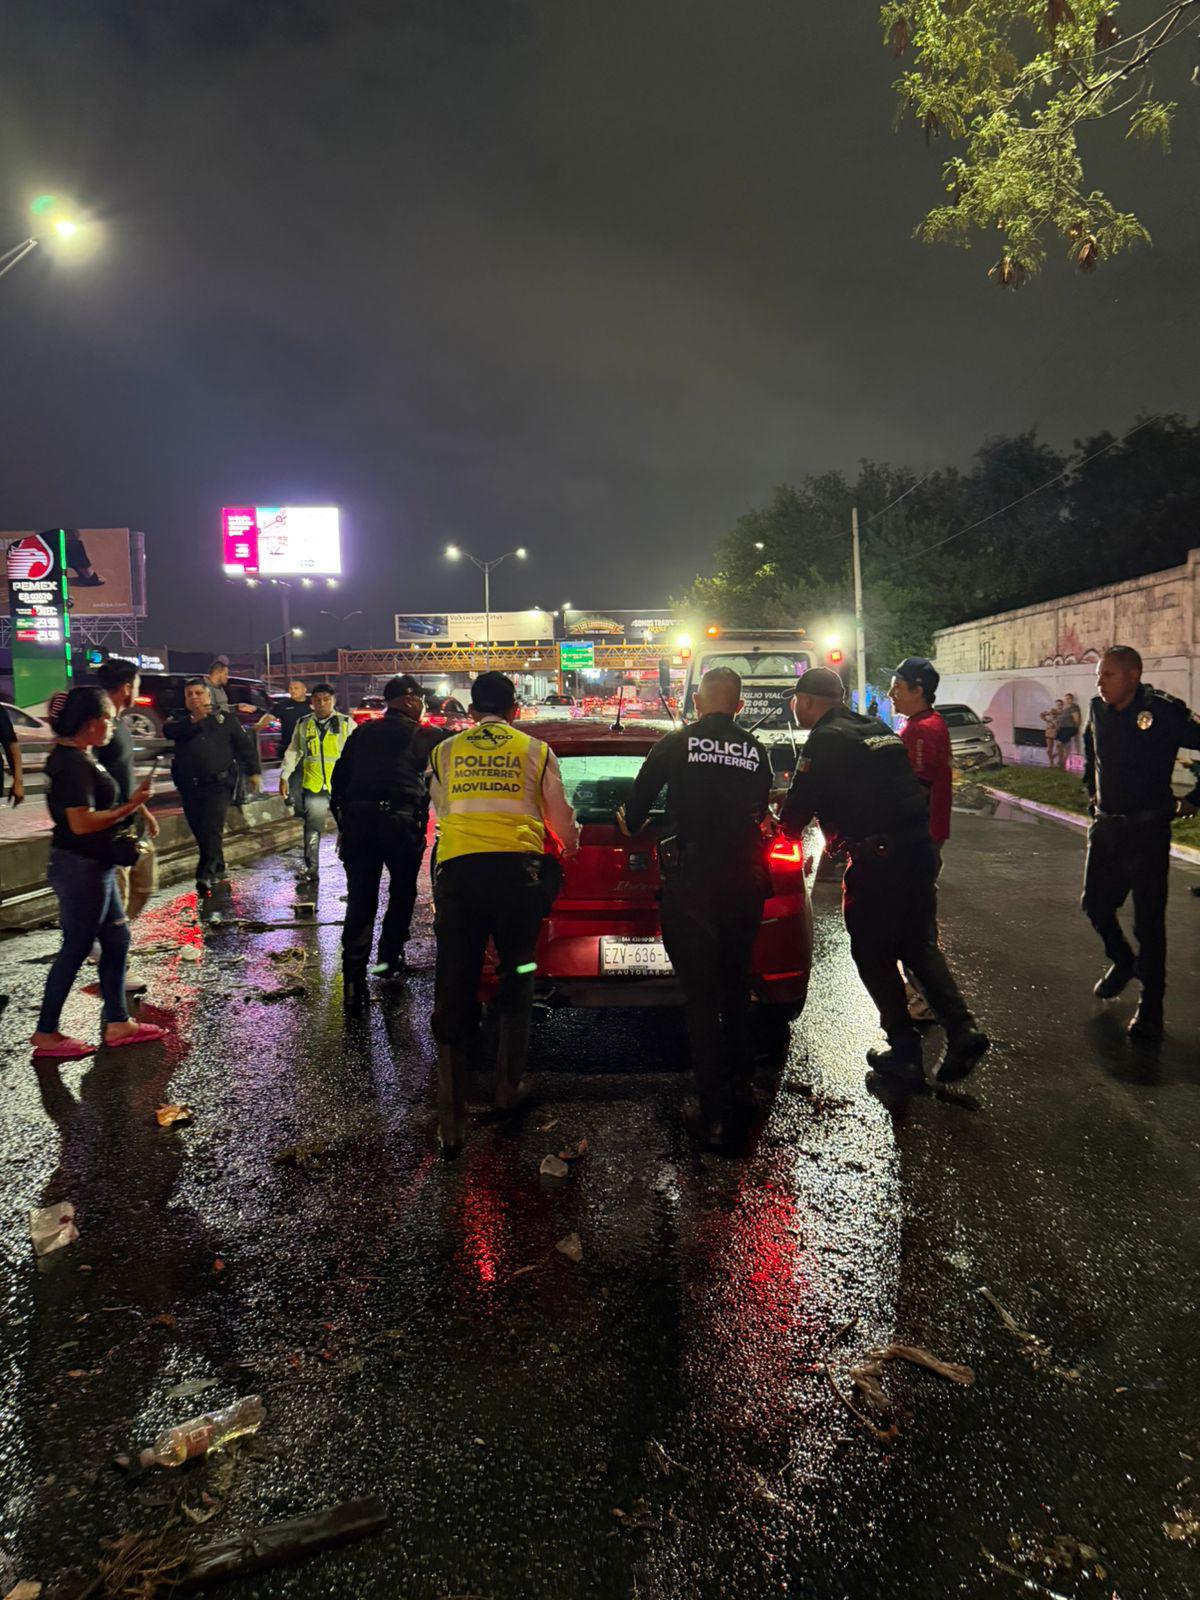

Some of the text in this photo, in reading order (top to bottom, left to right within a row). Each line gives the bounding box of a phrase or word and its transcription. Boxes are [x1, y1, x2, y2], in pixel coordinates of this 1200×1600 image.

[12, 581, 58, 591] PEMEX
[687, 736, 760, 762] POLICÍA
[454, 752, 522, 769] POLICÍA
[687, 752, 759, 772] MONTERREY
[454, 768, 521, 779] MONTERREY
[452, 782, 521, 793] MOVILIDAD
